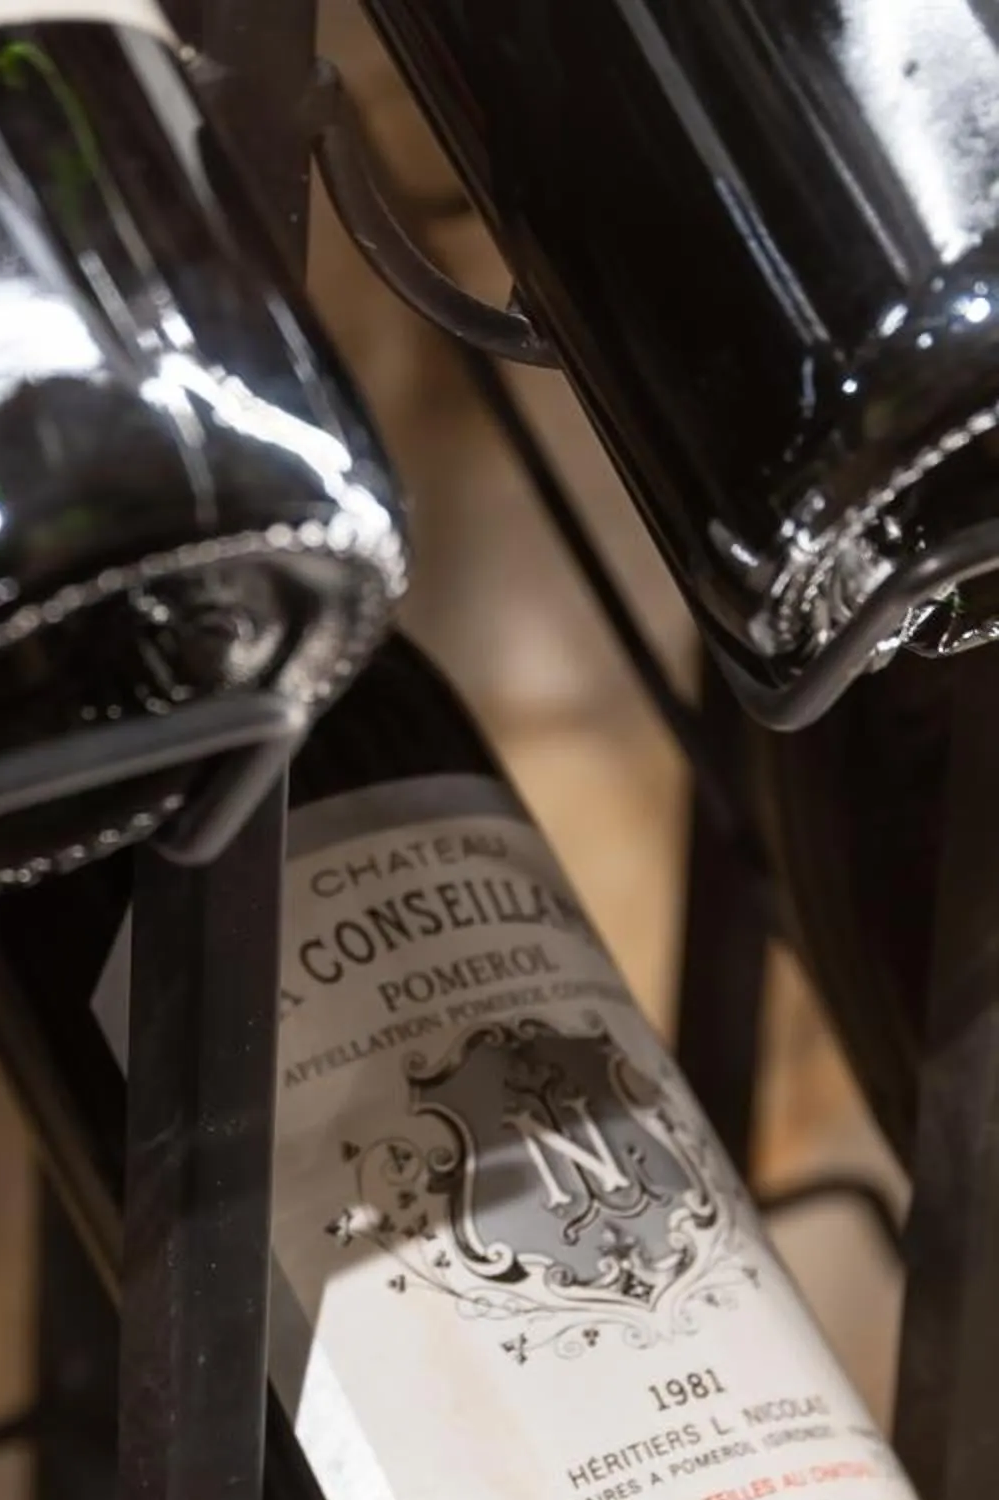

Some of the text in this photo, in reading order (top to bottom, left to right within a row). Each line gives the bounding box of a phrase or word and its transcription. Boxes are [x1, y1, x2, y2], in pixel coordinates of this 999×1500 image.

[309, 833, 508, 898] CHATEAU
[377, 944, 561, 1013] POMEROL
[283, 1009, 443, 1088] APPELLATION
[648, 1368, 725, 1412] 1981
[567, 1424, 701, 1490] HÉRITIERS
[650, 1472, 664, 1487] A
[668, 1442, 757, 1477] POMEROL
